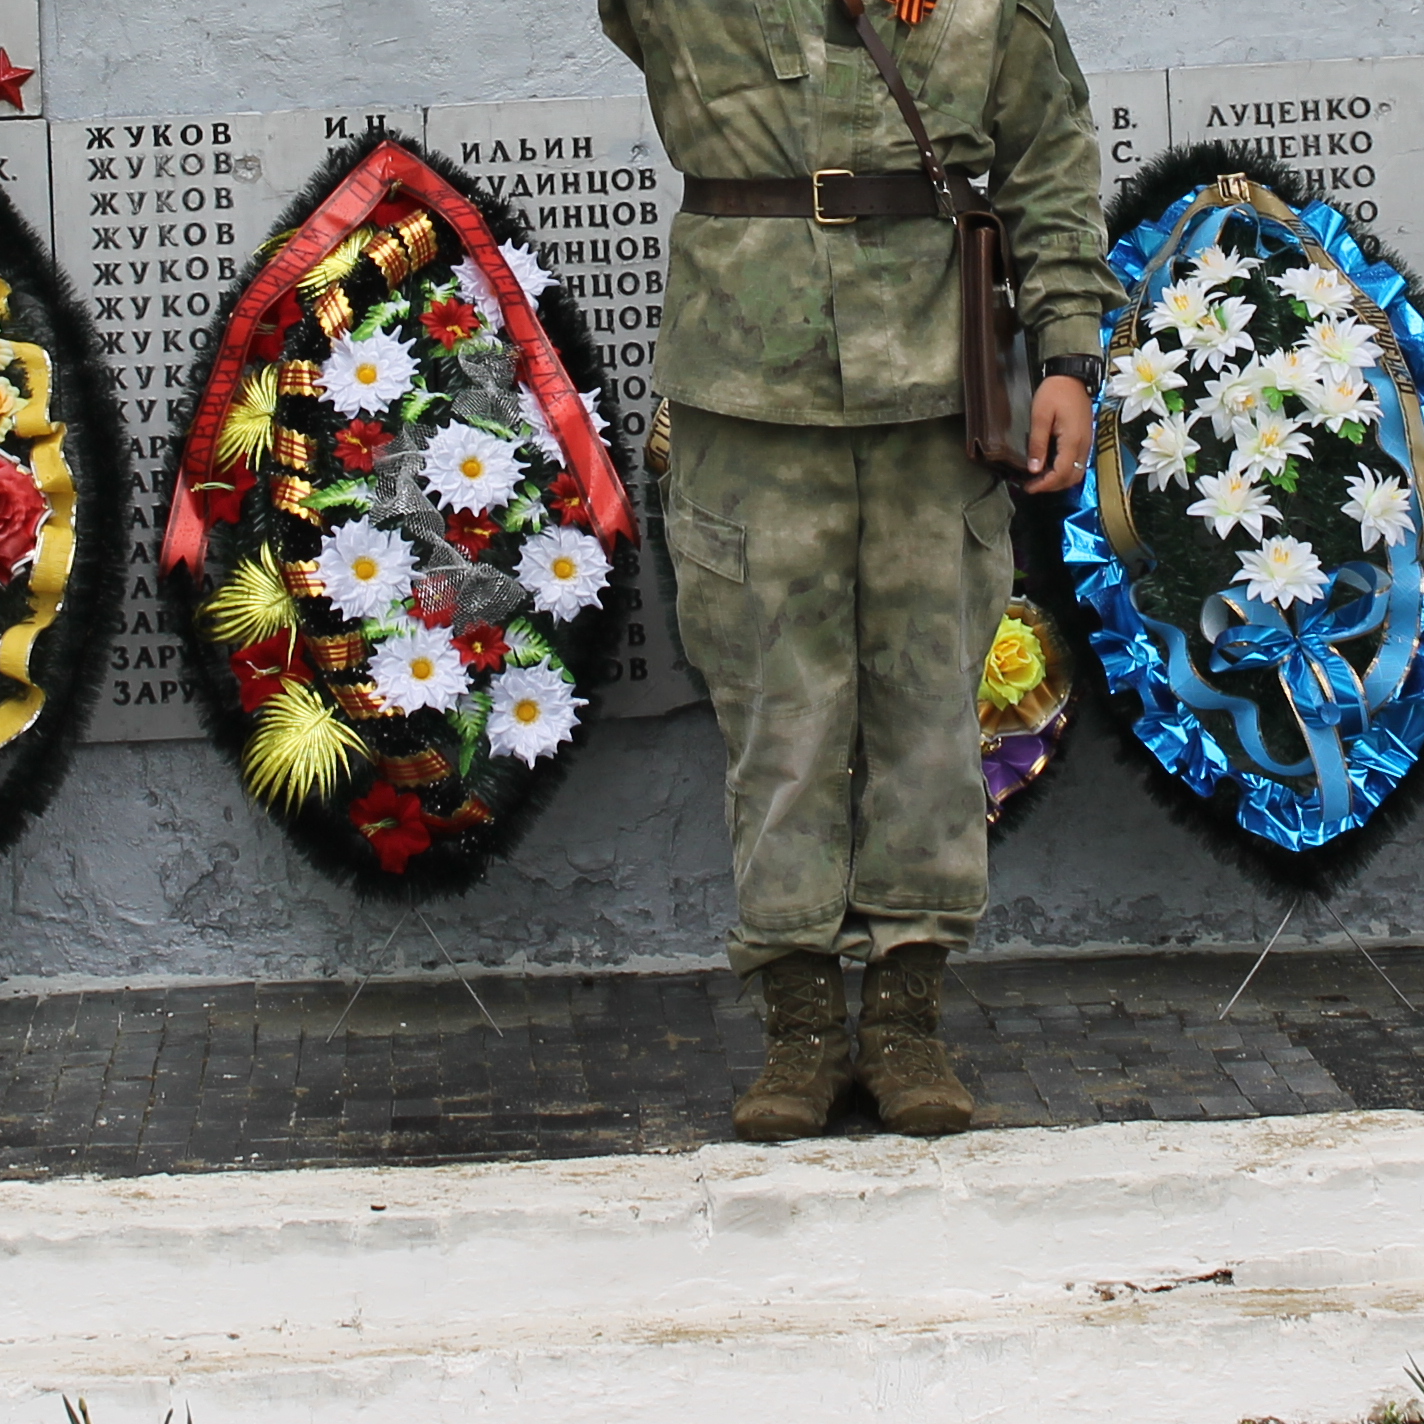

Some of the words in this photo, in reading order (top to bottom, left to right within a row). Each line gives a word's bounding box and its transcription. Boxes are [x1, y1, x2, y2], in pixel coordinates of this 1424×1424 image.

[1206, 97, 1371, 128] ЛУЦЕНКО
[86, 123, 231, 150] ЖУКОВ
[461, 137, 592, 164] ИЛЬИН
[92, 223, 234, 250] ЖУКОВ
[93, 257, 235, 286] ЖУКОВ
